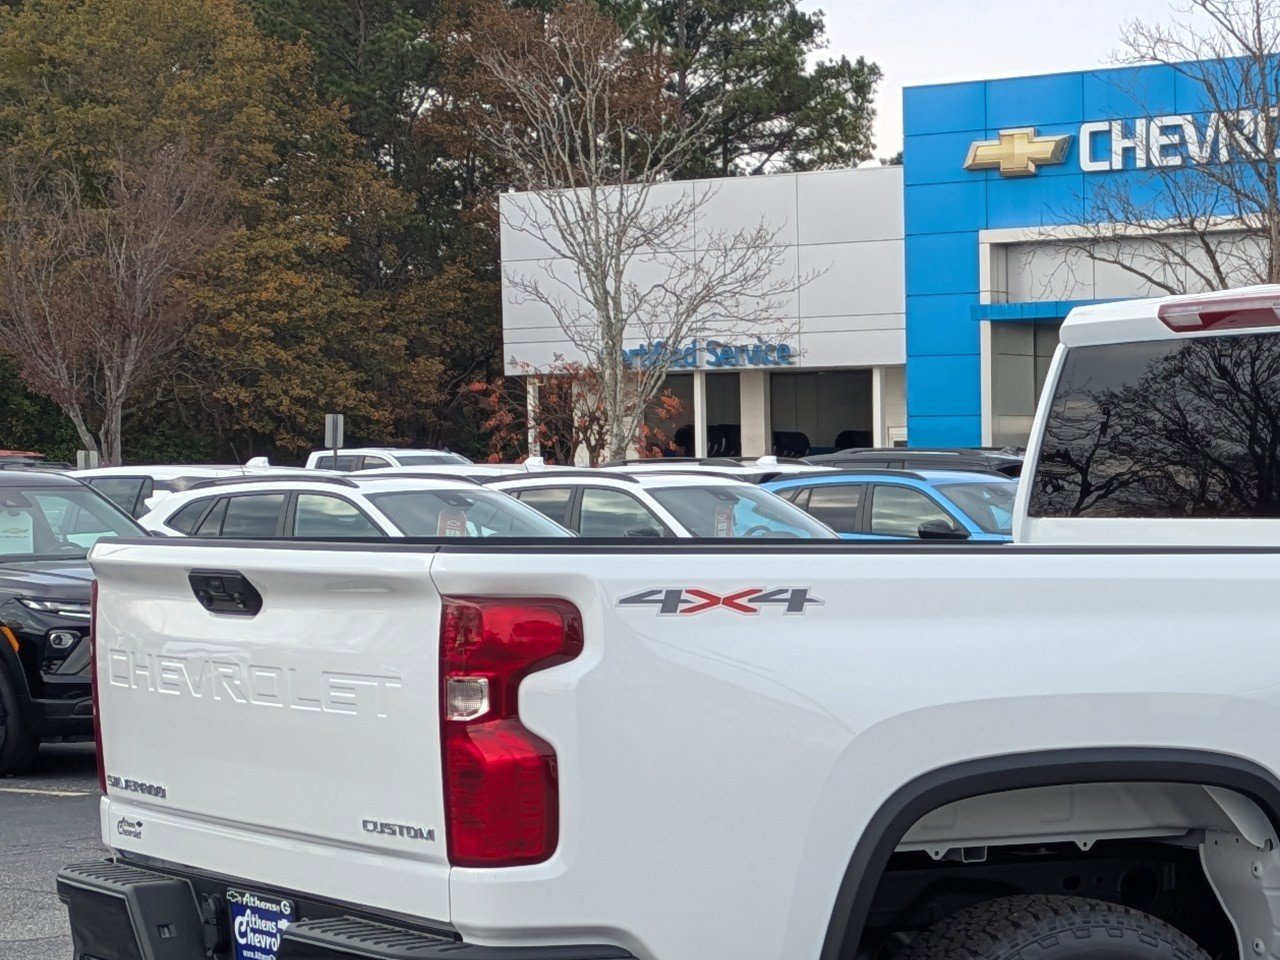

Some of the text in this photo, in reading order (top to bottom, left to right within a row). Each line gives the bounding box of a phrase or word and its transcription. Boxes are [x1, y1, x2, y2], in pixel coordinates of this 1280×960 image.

[604, 339, 797, 370] ertified Service
[109, 648, 402, 718] CHEVROLET
[107, 775, 167, 799] SILVERADO
[362, 819, 436, 842] CUSTOM
[242, 893, 280, 912] Athens
[234, 915, 281, 952] Chevrol
[244, 908, 278, 934] Athens
